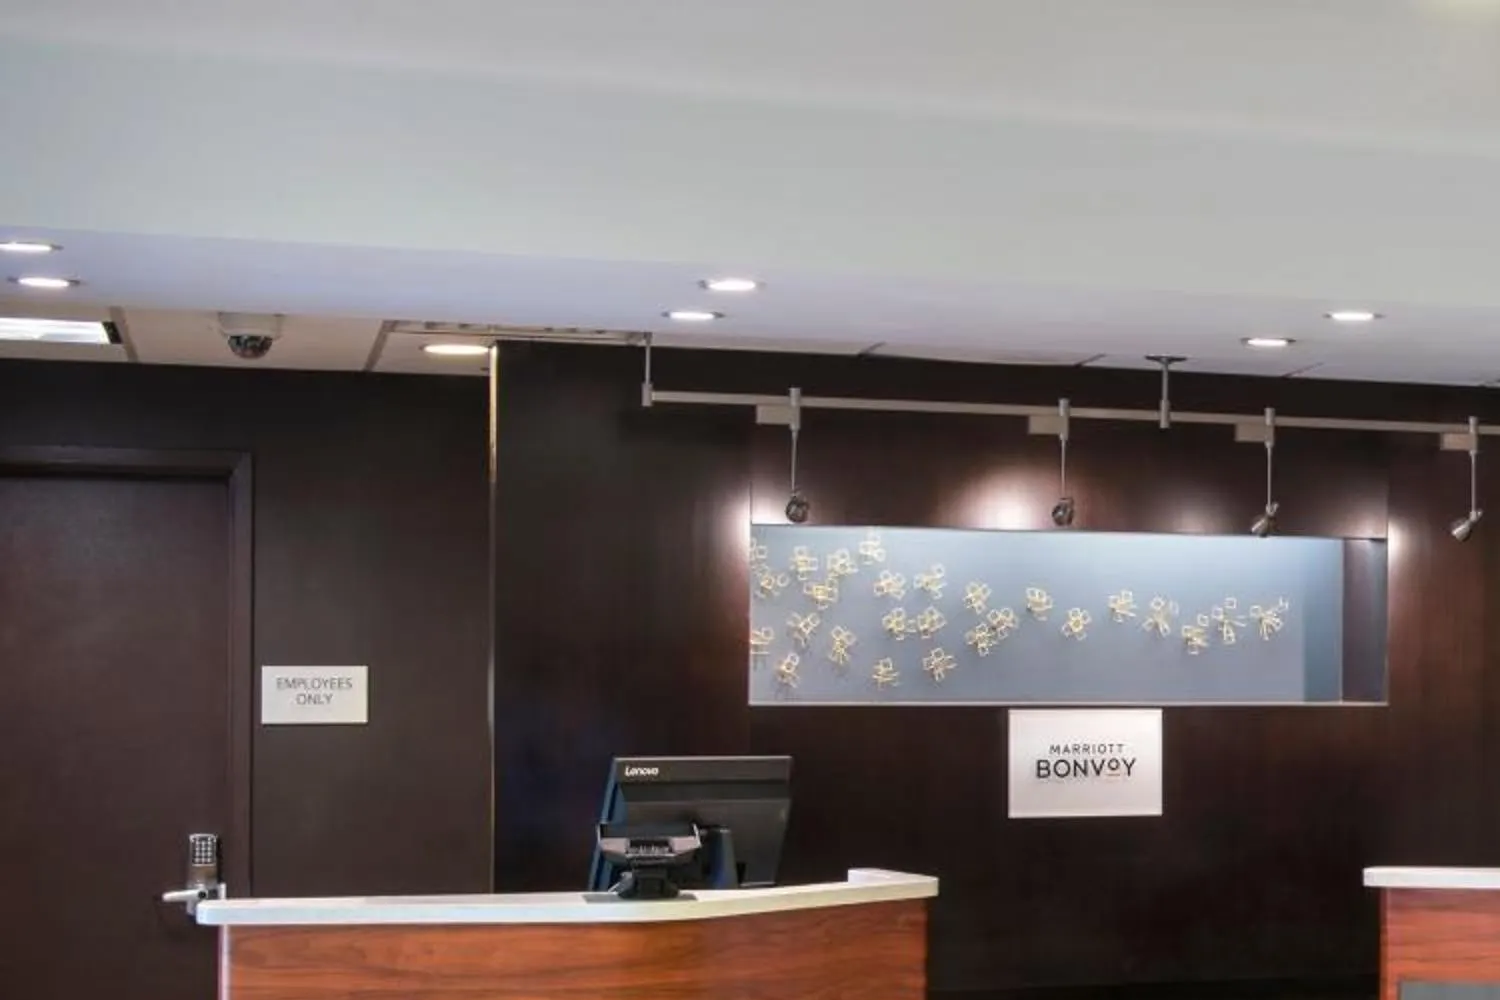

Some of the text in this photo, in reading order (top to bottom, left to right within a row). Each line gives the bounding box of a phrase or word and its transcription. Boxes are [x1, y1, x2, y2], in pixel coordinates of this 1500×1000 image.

[275, 677, 353, 690] EMPLOYEES
[296, 692, 334, 705] ONLY
[1049, 743, 1126, 755] MARRIOTT
[624, 765, 660, 777] Lenovo
